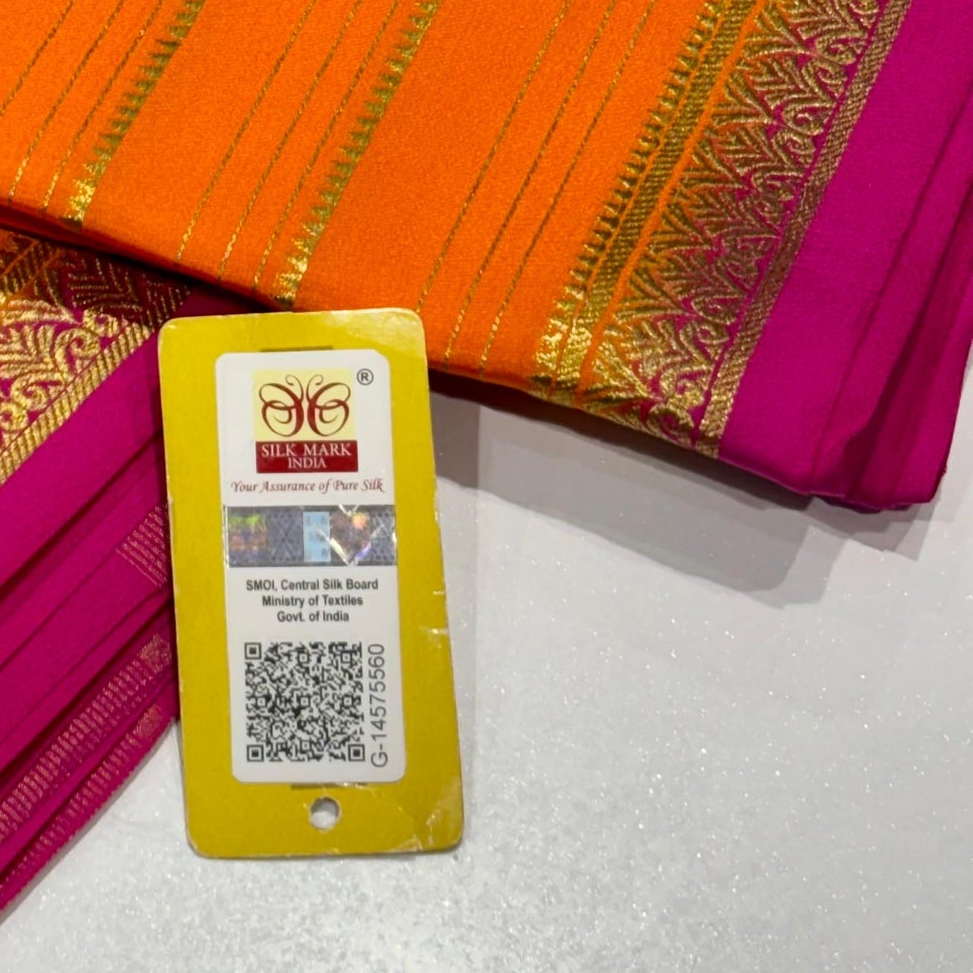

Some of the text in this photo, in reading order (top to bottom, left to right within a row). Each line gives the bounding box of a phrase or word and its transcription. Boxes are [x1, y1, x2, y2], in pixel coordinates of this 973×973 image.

[261, 442, 351, 457] SILK MARK
[287, 456, 326, 469] INDIA
[230, 478, 385, 495] Your Assurance of Pure Silk
[280, 579, 320, 591] Central
[322, 578, 343, 590] Silk
[345, 578, 379, 590] Board
[262, 594, 363, 608] Ministry of Textiles
[277, 610, 350, 623] Govt. of India
[368, 643, 388, 768] G-14575560
